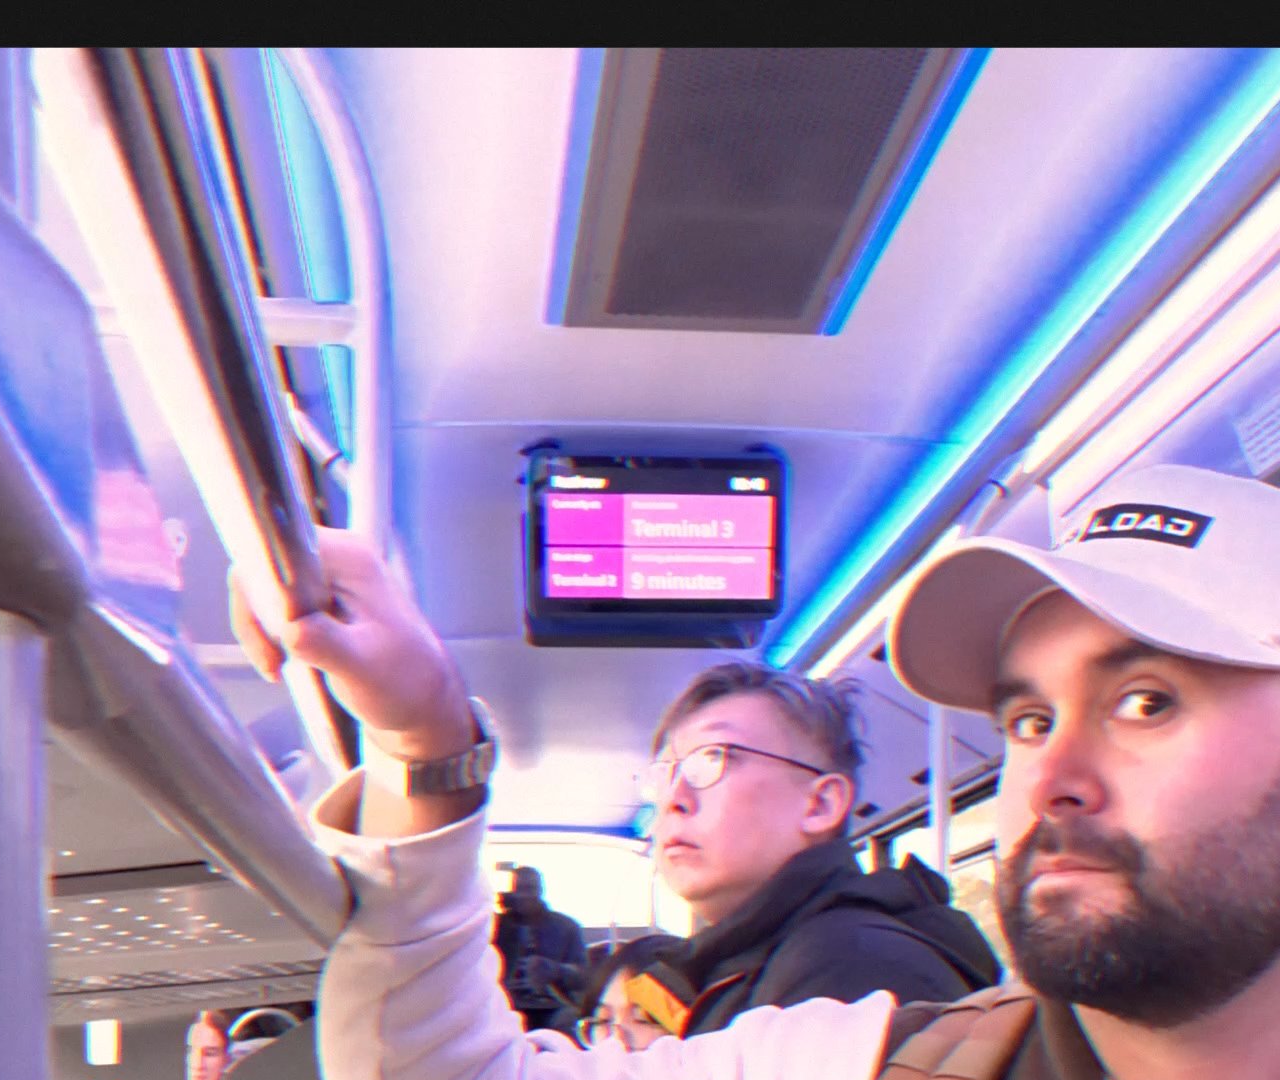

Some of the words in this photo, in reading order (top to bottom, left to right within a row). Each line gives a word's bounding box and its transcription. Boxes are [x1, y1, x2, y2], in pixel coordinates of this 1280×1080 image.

[631, 519, 718, 538] Terminal
[721, 520, 735, 539] 3
[631, 572, 645, 590] 9
[647, 572, 727, 590] minutes
